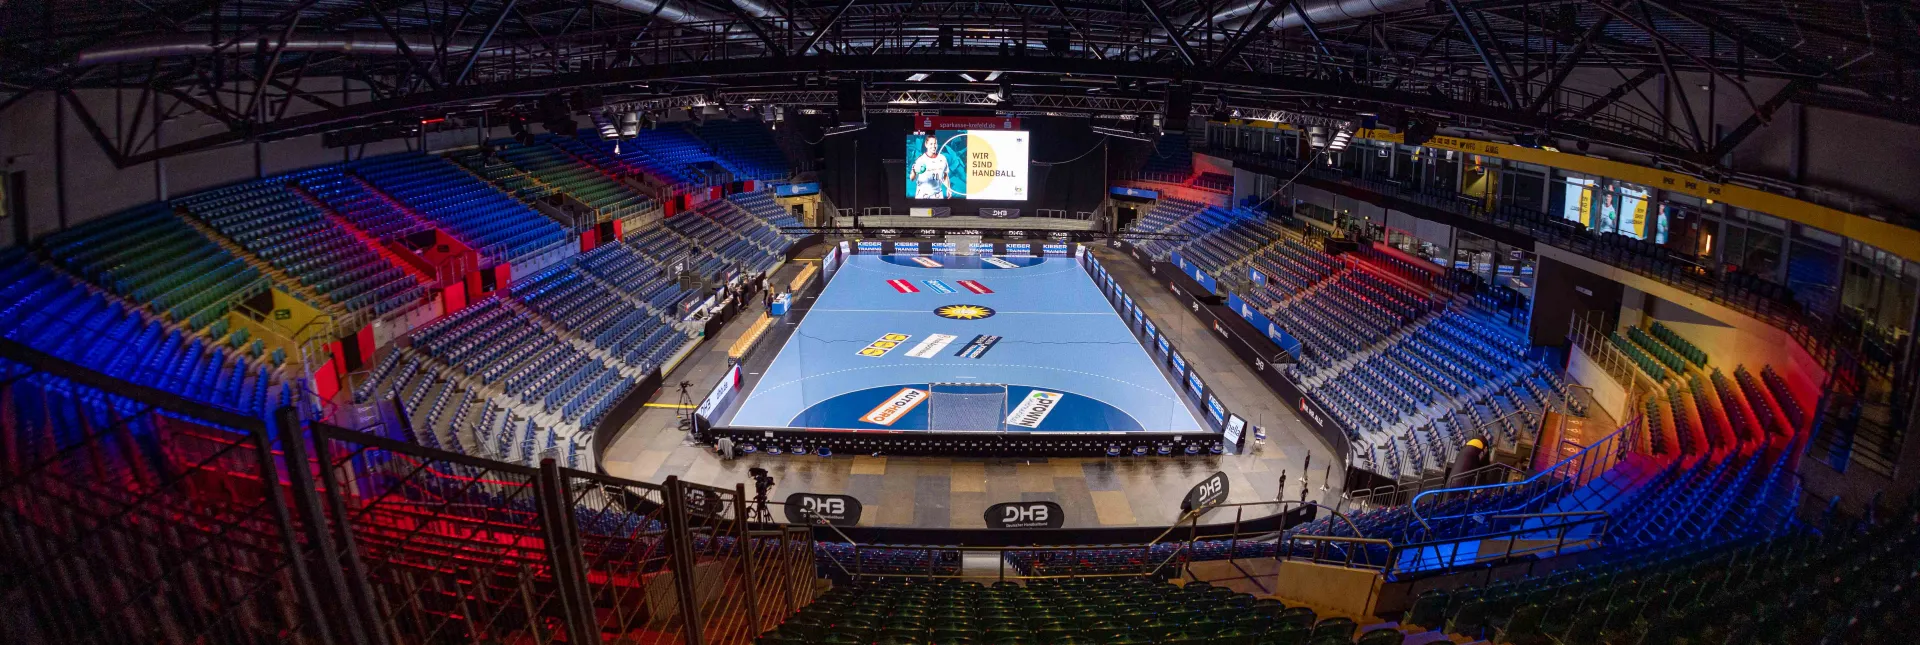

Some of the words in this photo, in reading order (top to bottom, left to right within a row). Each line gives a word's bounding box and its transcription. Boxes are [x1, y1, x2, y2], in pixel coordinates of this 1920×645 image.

[972, 152, 989, 160] WIR
[873, 390, 920, 422] AUTOHERO
[1227, 421, 1241, 437] hella
[1199, 476, 1222, 502] DHB
[800, 496, 845, 514] DHB
[1003, 504, 1048, 523] DHB
